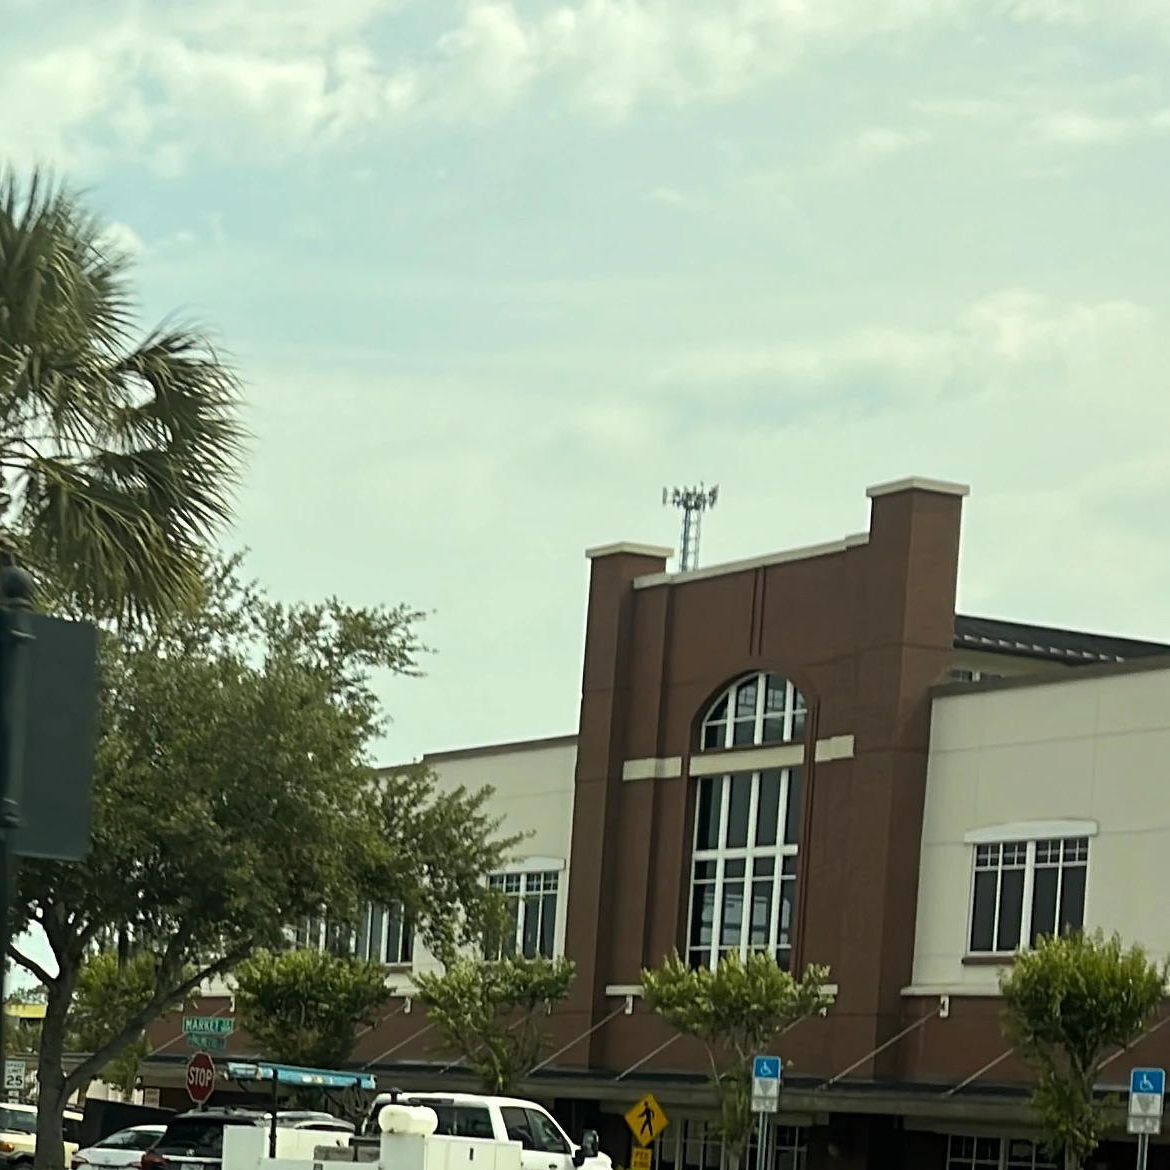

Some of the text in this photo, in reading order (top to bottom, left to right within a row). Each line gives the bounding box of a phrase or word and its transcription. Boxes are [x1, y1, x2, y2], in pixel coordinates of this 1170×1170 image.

[185, 1019, 219, 1032] MARKET
[6, 1075, 23, 1086] 25
[189, 1066, 213, 1087] STOP
